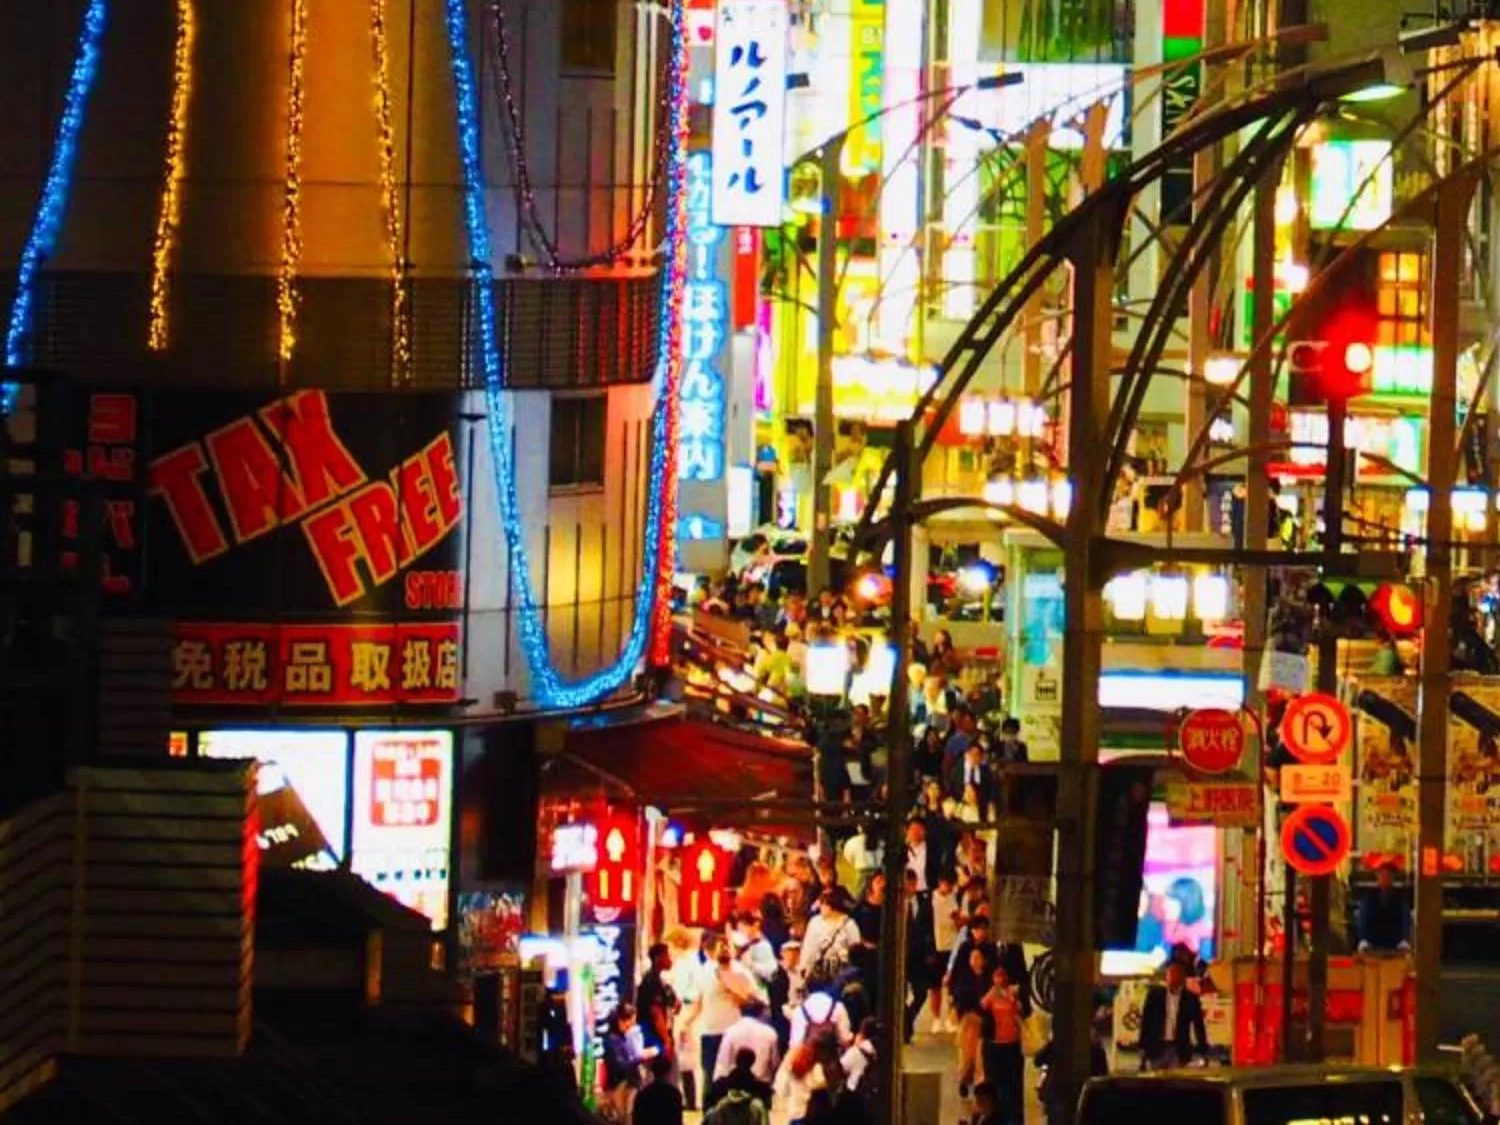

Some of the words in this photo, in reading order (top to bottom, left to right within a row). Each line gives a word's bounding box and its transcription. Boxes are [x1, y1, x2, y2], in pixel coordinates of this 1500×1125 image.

[727, 40, 768, 195] ルノアール
[147, 387, 368, 566] TAX
[299, 430, 463, 608] FREE
[171, 639, 461, 692] 免税品取扱店
